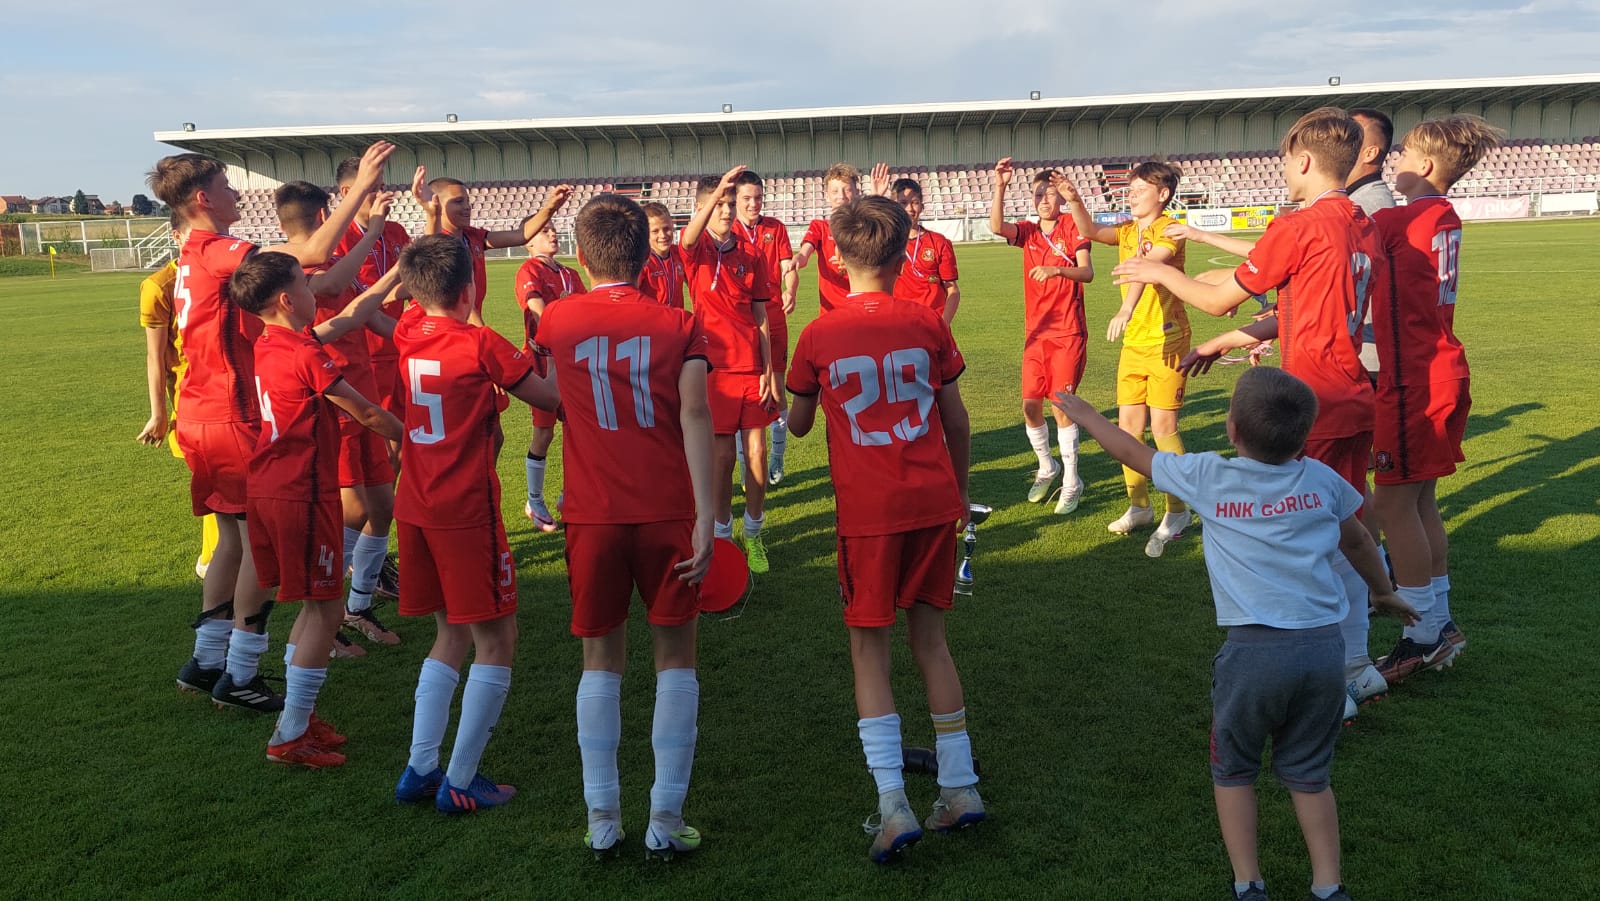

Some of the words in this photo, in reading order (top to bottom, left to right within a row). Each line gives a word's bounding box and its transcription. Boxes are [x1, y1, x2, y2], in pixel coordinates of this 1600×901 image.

[408, 358, 446, 444] 5
[574, 335, 655, 431] 11
[828, 347, 935, 446] 29
[1215, 502, 1255, 518] HNK
[1261, 492, 1323, 517] GORICA
[318, 544, 334, 577] 4
[500, 551, 512, 587] 5
